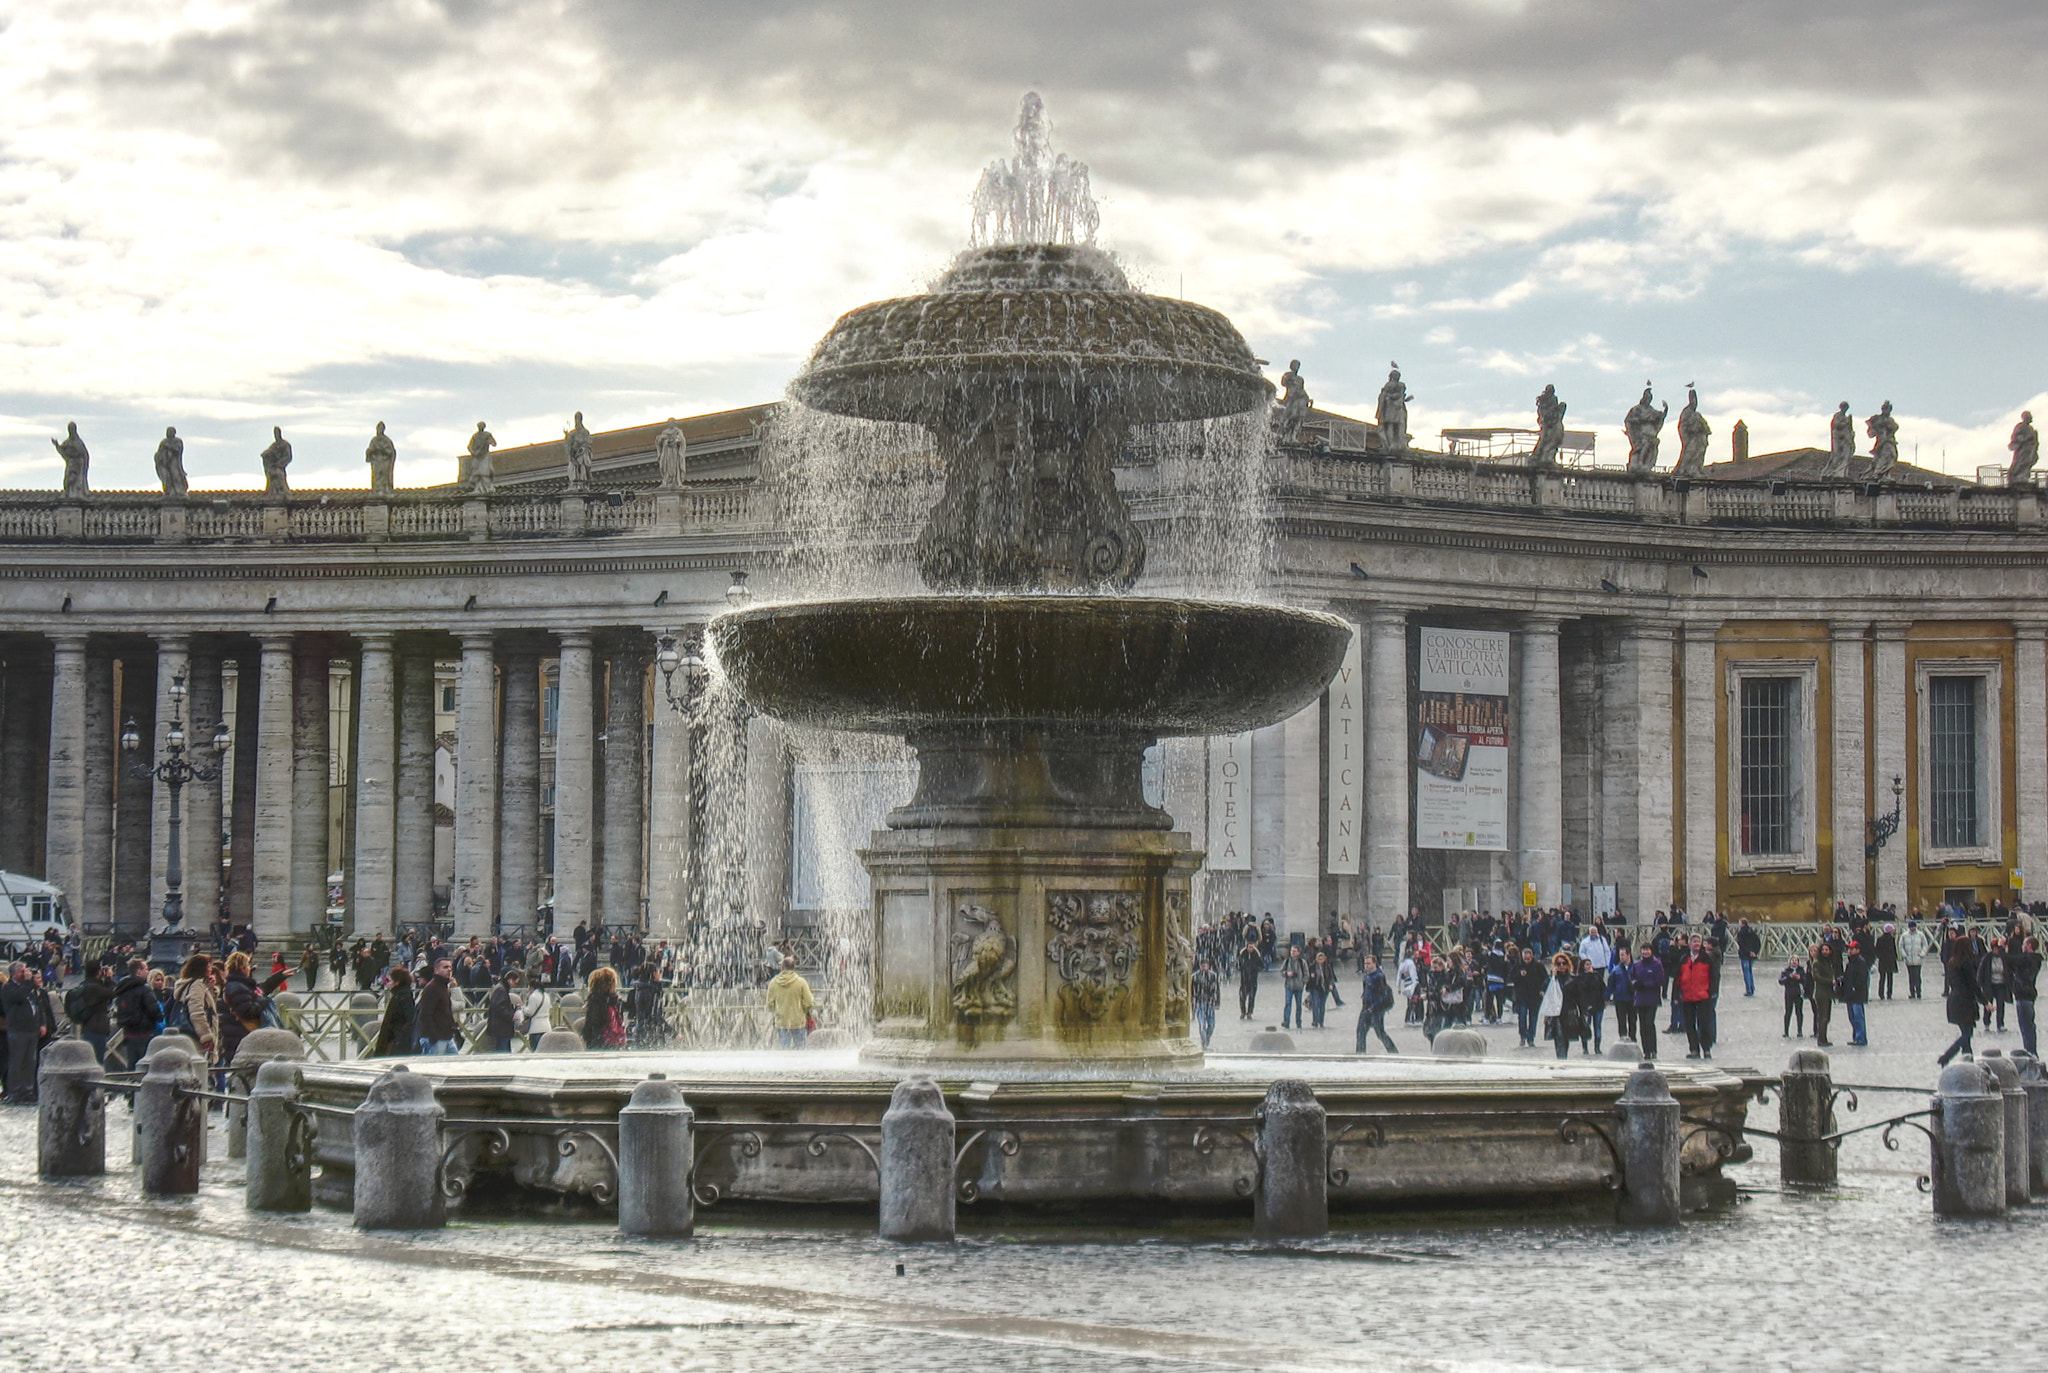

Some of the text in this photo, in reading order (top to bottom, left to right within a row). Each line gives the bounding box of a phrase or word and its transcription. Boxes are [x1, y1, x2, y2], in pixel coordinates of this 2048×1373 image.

[1426, 635, 1504, 652] CONOSCERE
[1426, 647, 1504, 662] LA BIBLIOTECA
[1427, 658, 1504, 678] VATICANA
[1456, 724, 1504, 735] UNA STORIA APERTA
[1478, 736, 1504, 746] AL FUTURO
[1339, 668, 1353, 862] VATICANA
[1222, 733, 1239, 858] IOTECA
